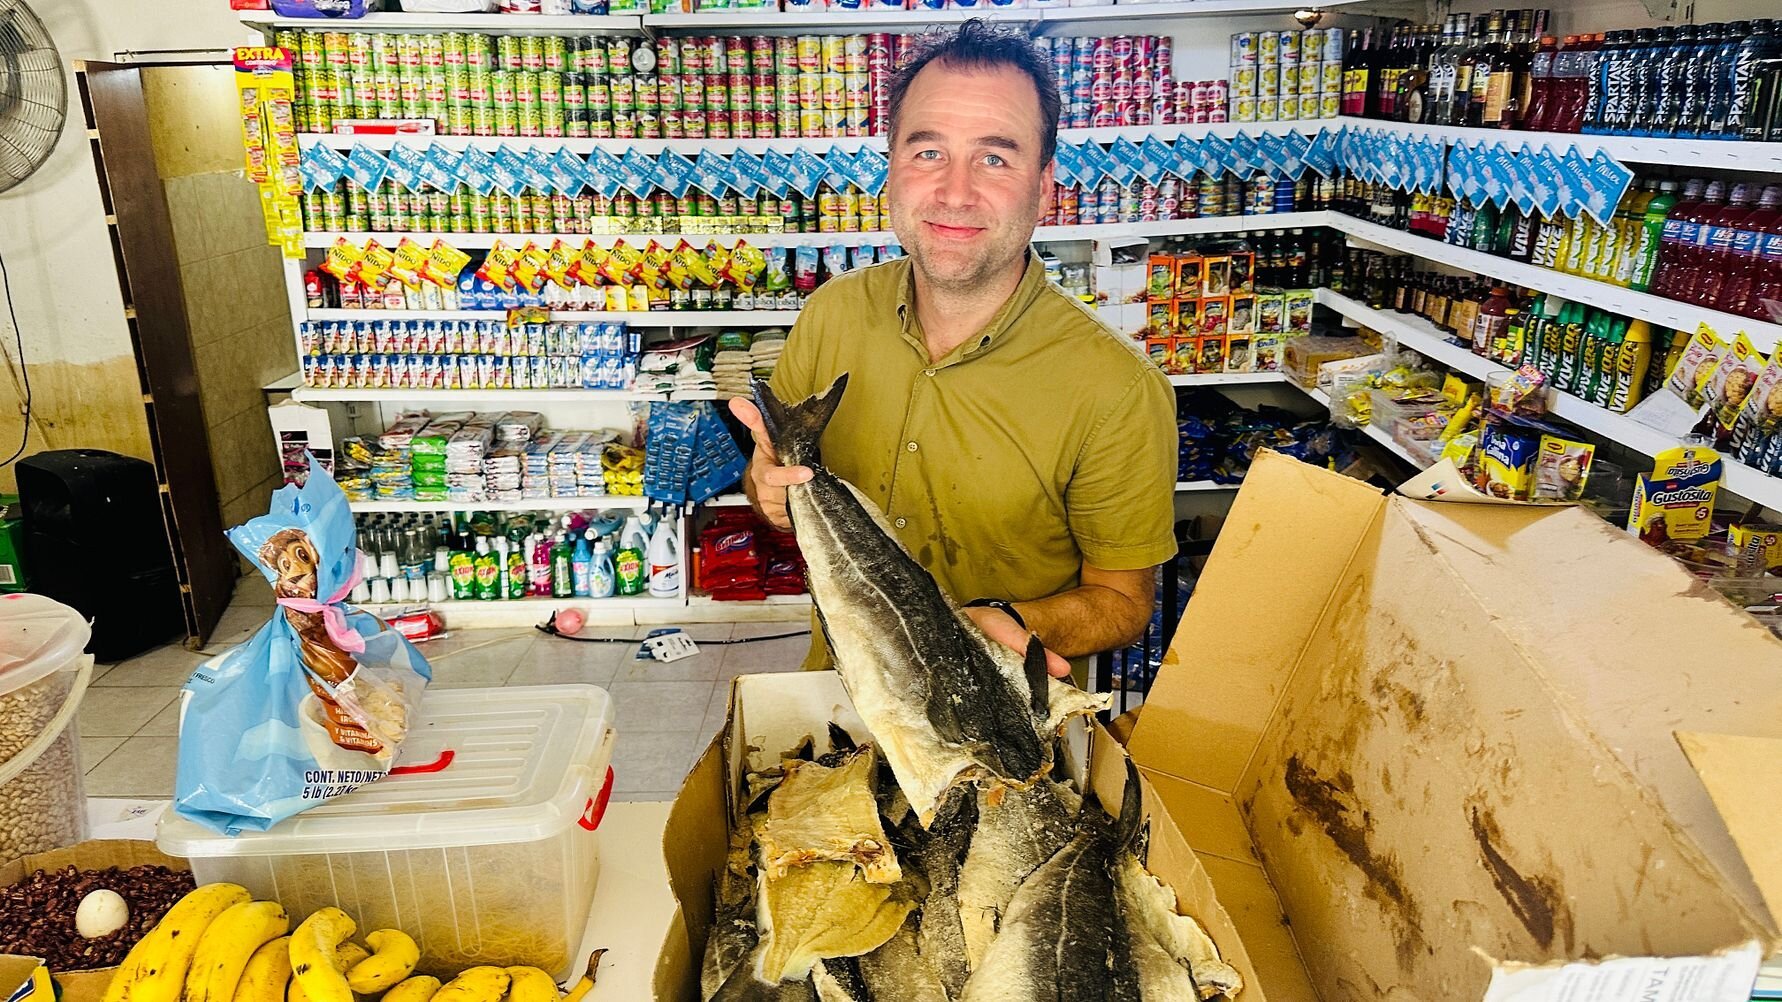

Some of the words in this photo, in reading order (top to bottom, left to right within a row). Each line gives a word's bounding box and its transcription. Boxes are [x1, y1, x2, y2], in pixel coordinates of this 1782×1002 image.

[236, 47, 285, 60] EXTRA
[1605, 59, 1622, 123] SPARTAN
[1727, 47, 1752, 126] SPARTAN
[1597, 163, 1619, 185] Milex
[1511, 217, 1531, 256] VIVE
[1532, 225, 1551, 265] VIVE
[1545, 225, 1562, 267] VIVE
[332, 248, 353, 265] NIDO
[365, 255, 385, 271] NIDO
[611, 249, 631, 266] NIDO
[1652, 487, 1713, 505] Gustosita
[305, 771, 335, 783] CONT.
[303, 787, 309, 799] 5
[312, 787, 322, 799] lb
